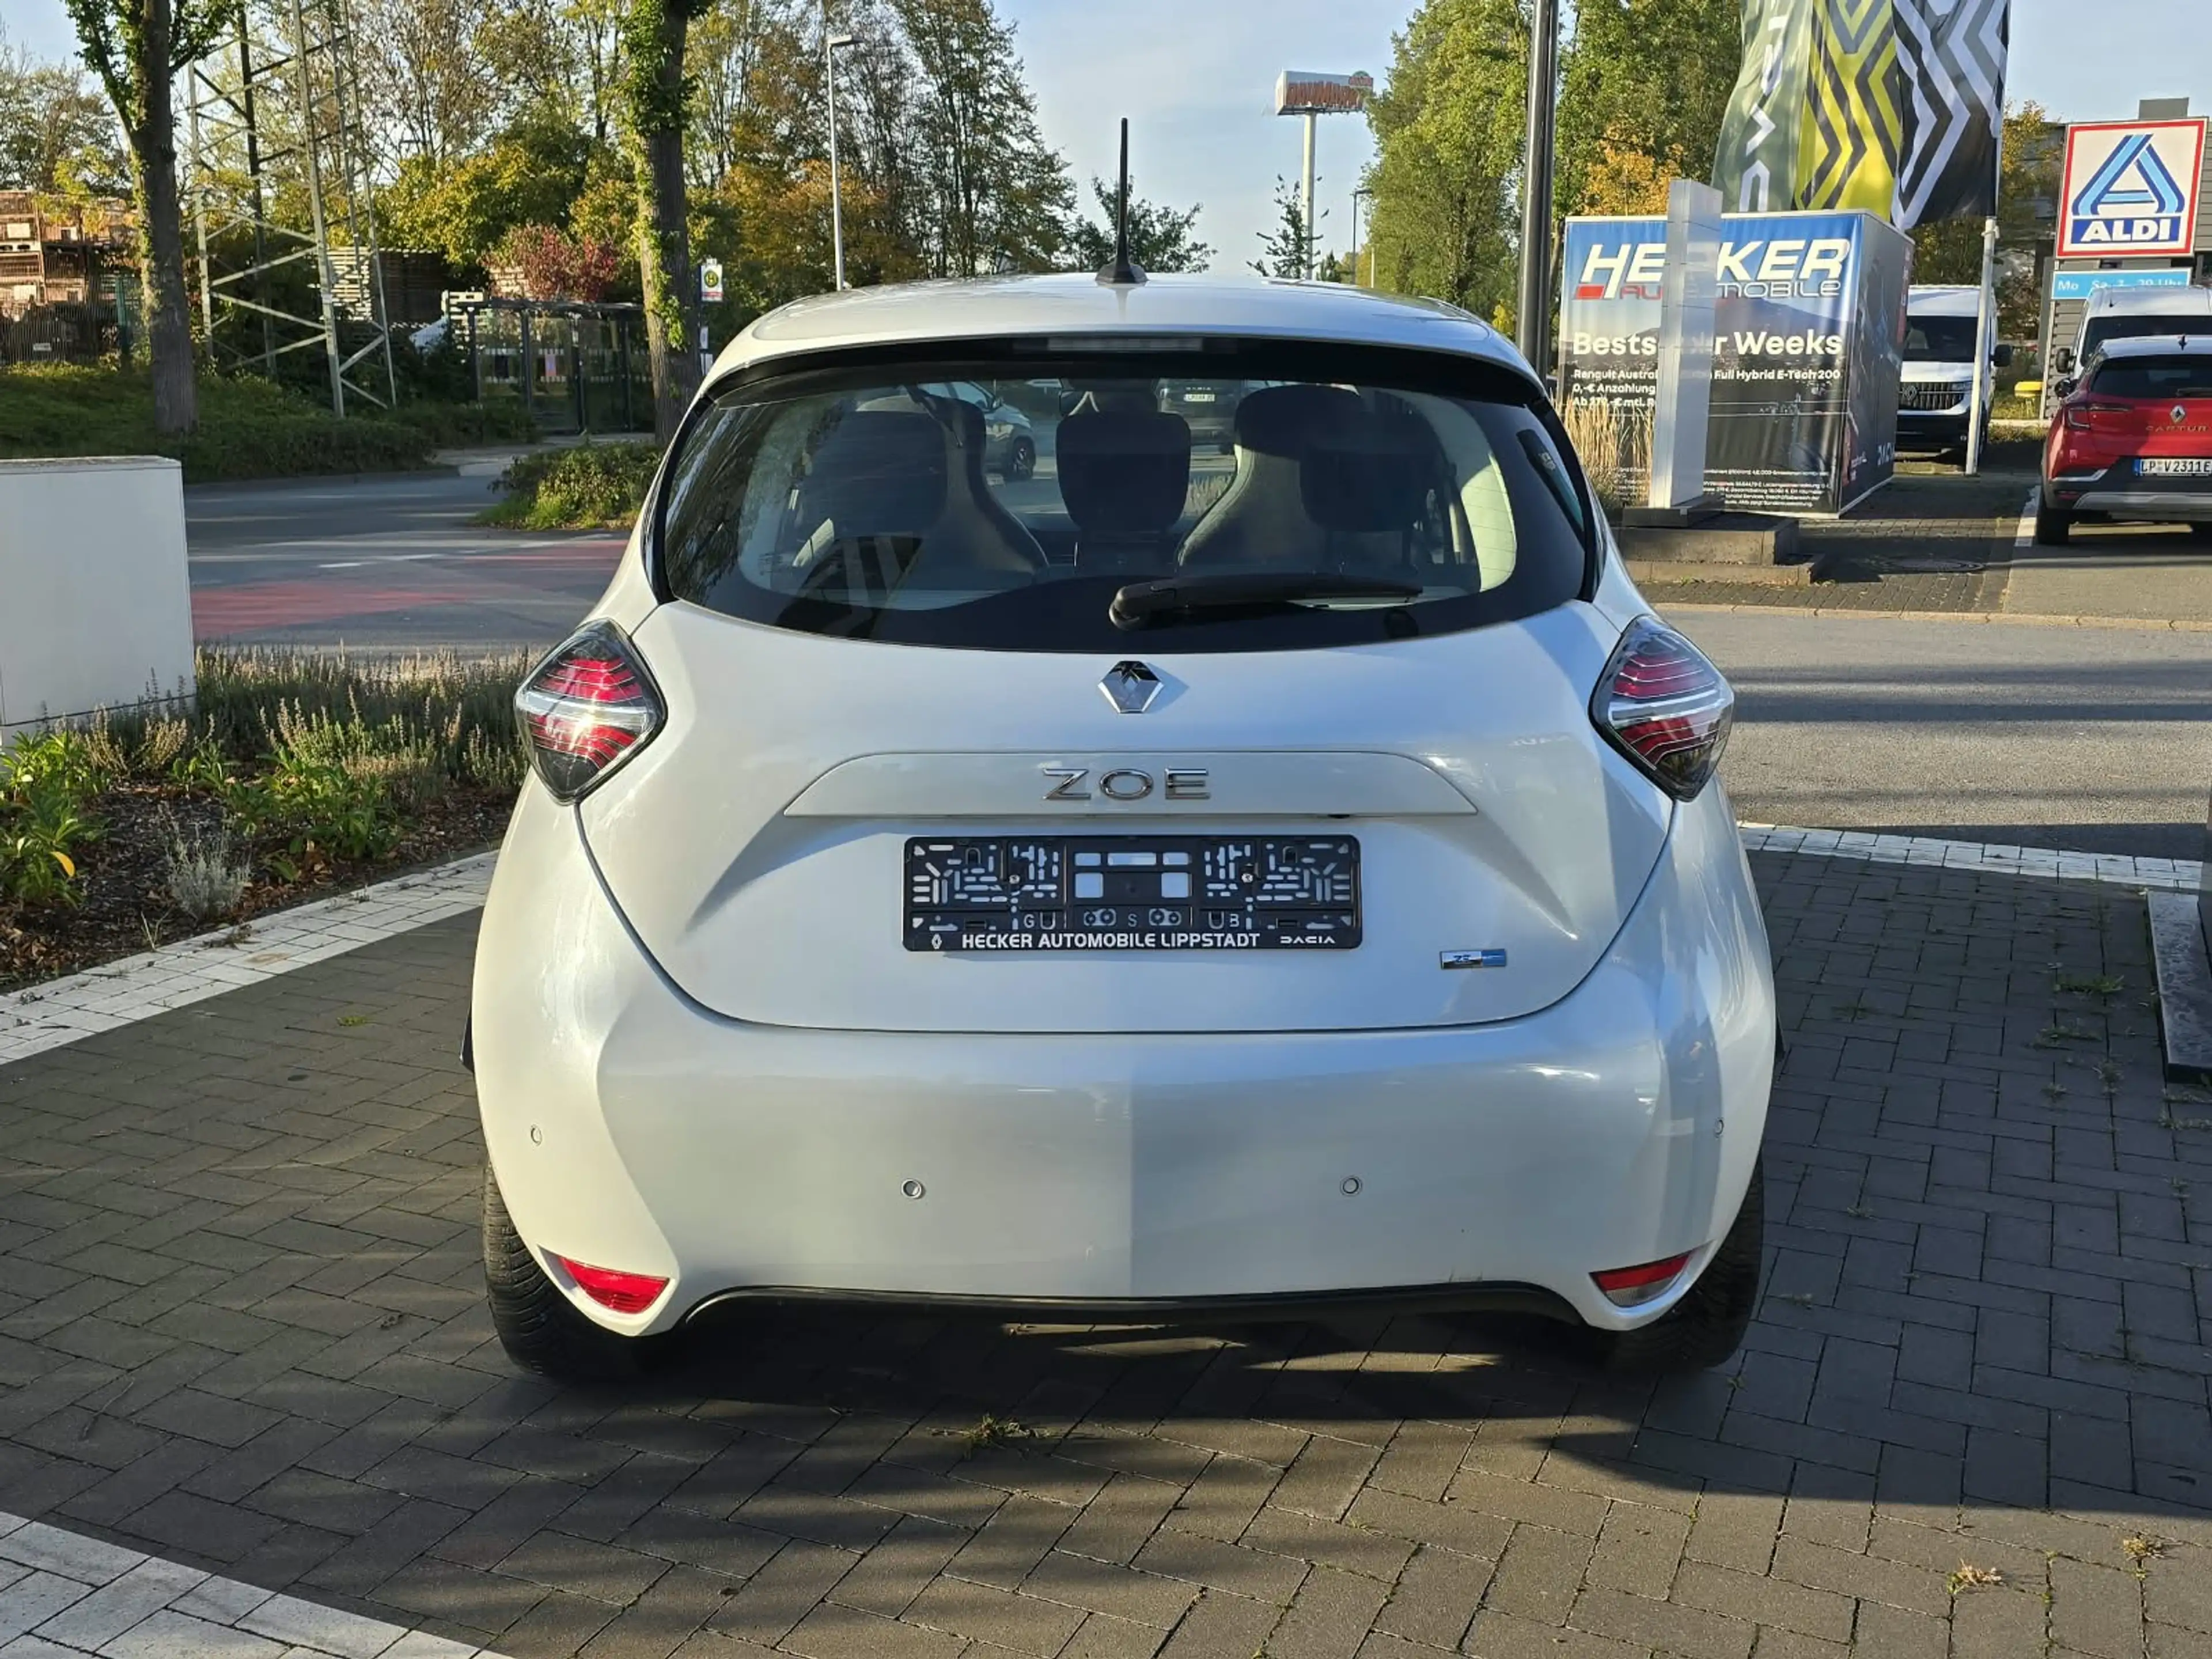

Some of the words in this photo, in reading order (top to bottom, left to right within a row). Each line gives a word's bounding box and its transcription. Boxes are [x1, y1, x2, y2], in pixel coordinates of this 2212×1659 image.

[2081, 219, 2171, 241] ALDI
[1580, 238, 1851, 299] HEKER
[1573, 331, 1728, 355] Bestsr
[1733, 329, 1843, 355] Weeks
[1714, 369, 1734, 380] Full
[1736, 369, 1775, 382] Hybrid
[1817, 370, 1841, 379] 200
[1596, 382, 1656, 395] Anzahlung
[2141, 461, 2156, 472] LP
[1042, 768, 1211, 801] ZOE
[961, 933, 1033, 949] HECKER
[1037, 932, 1156, 949] AUTOMOBILE
[1160, 932, 1260, 948] LIPPSTADT
[1280, 935, 1336, 944] DACIA
